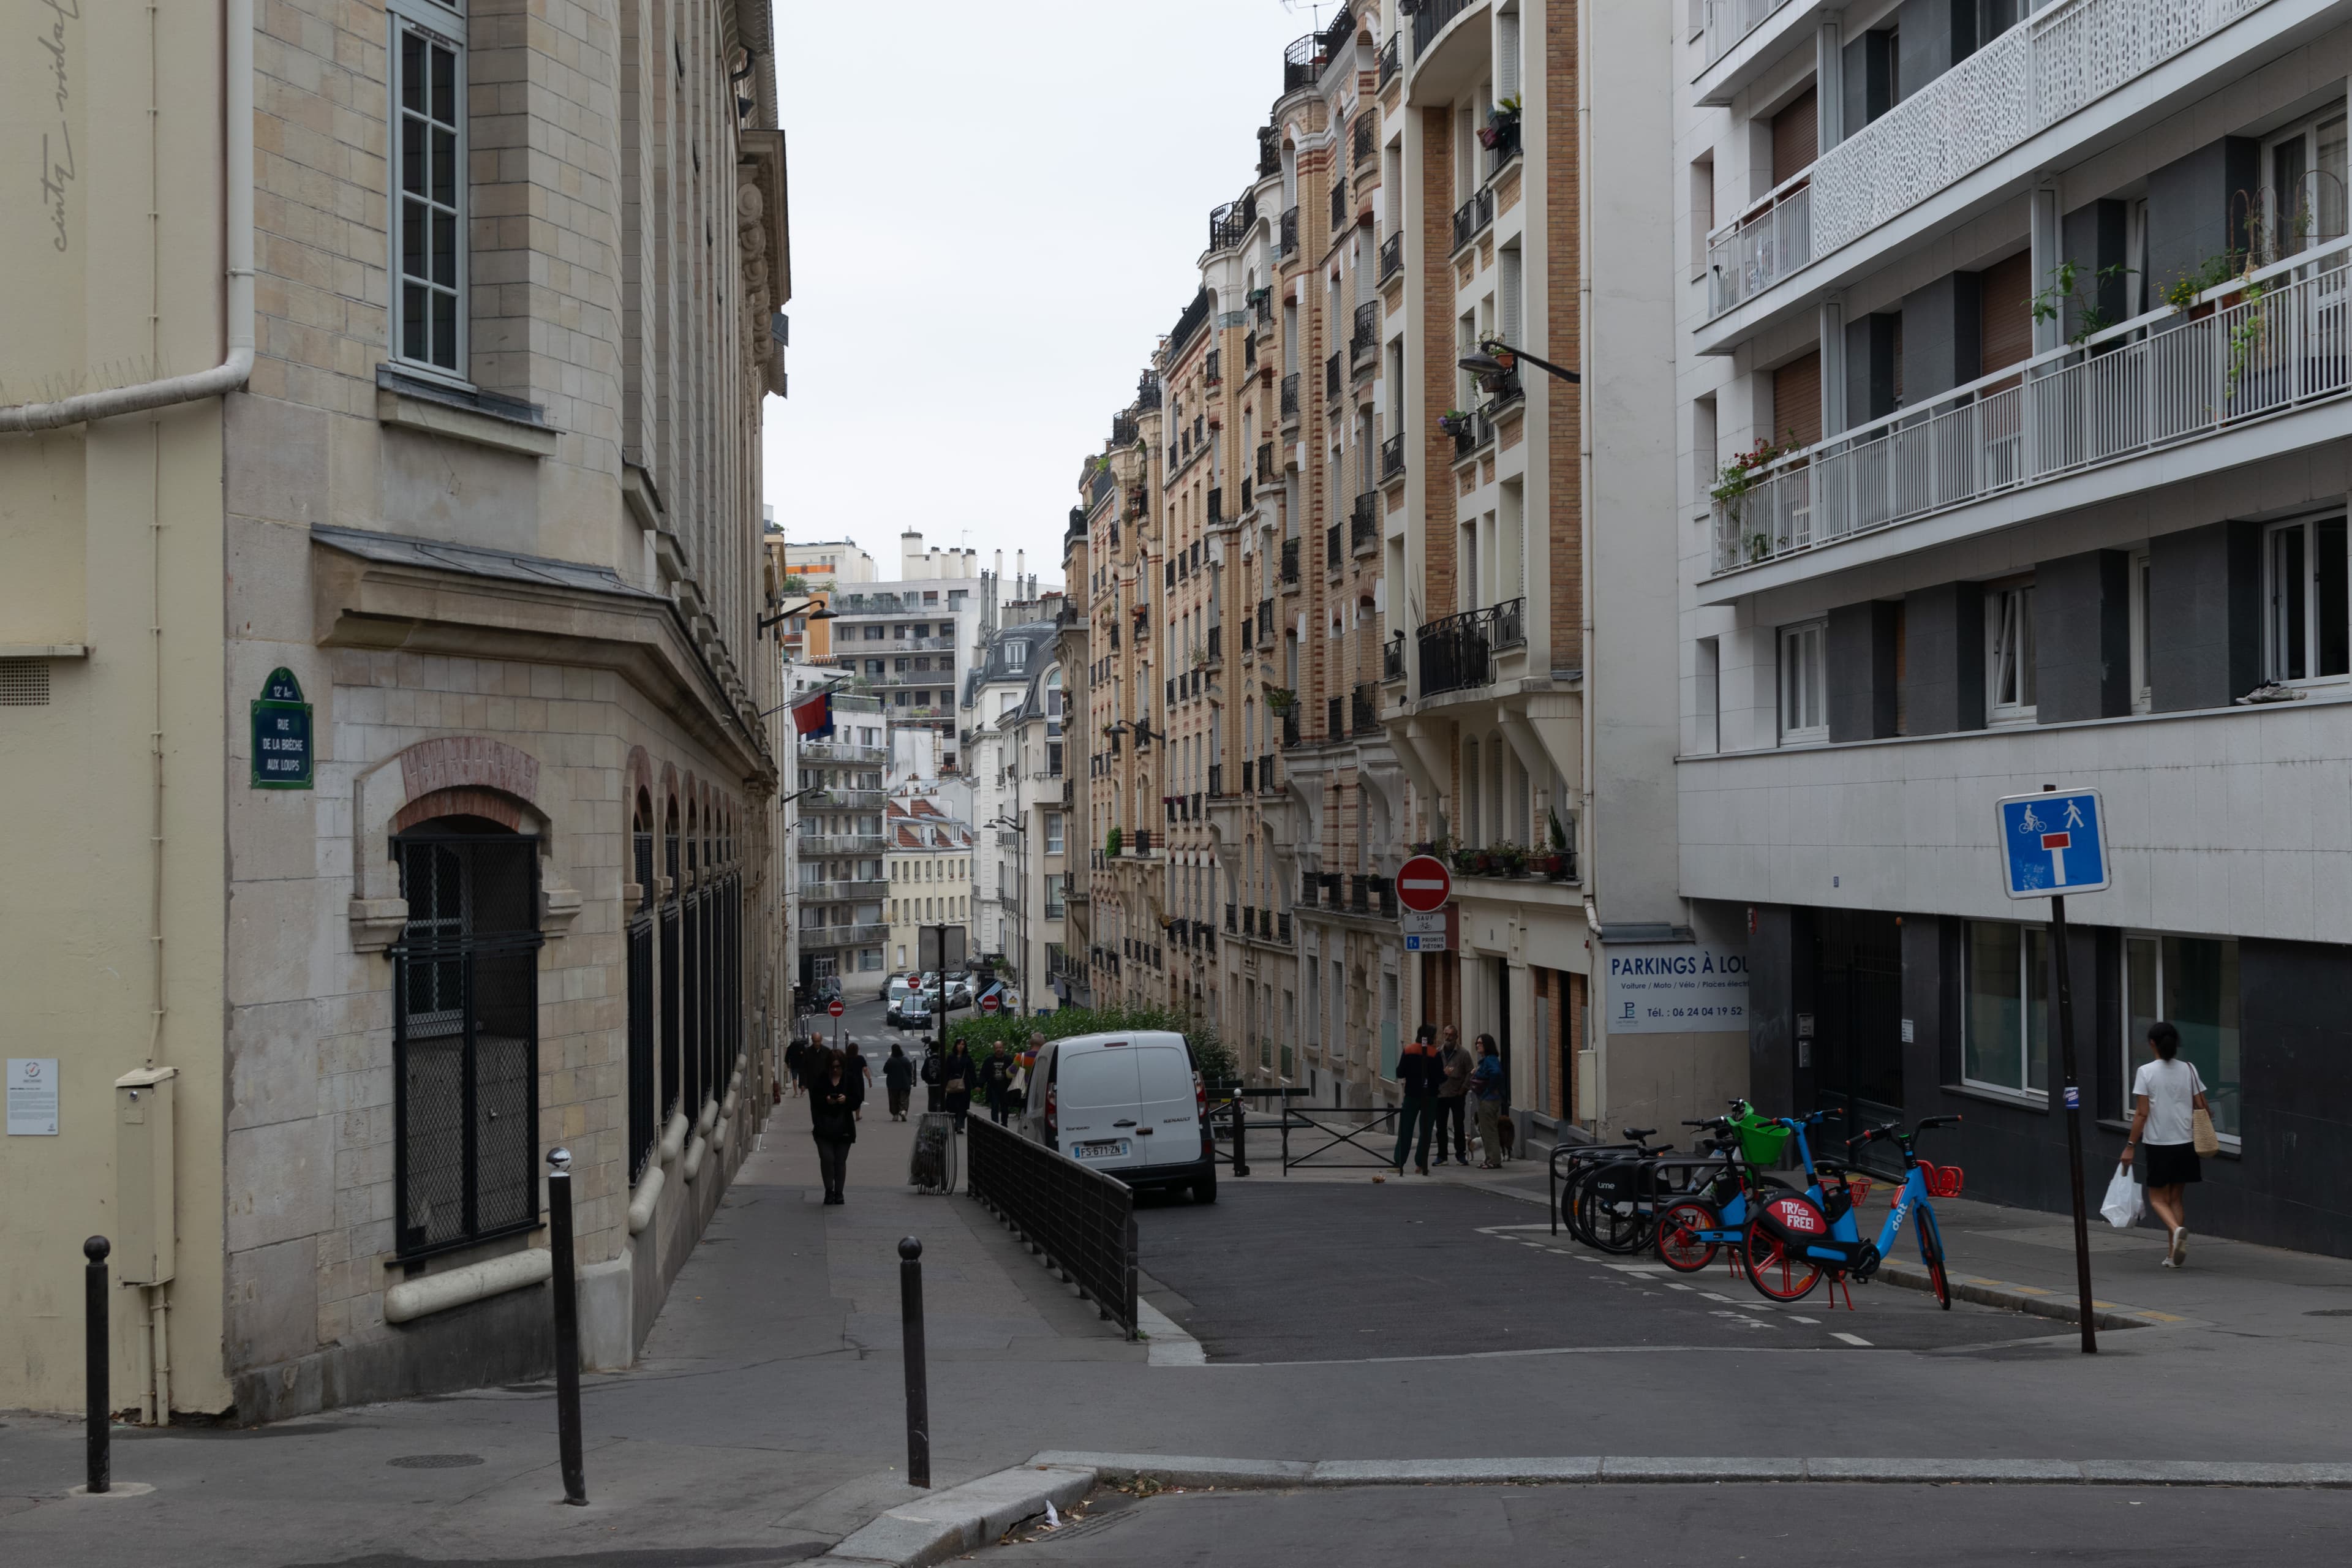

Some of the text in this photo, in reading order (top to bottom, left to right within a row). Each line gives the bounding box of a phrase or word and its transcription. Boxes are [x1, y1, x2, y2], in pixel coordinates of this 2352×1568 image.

[277, 718, 289, 730] RUE
[263, 737, 303, 752] DE LA BRÈCHE
[267, 758, 300, 771] AUX LOUPS
[1611, 956, 1696, 976] PARKINGS
[1702, 951, 1714, 974] À
[1648, 1008, 1664, 1017] Tél.
[1673, 1008, 1684, 1017] 06
[1687, 1008, 1699, 1017] 24
[1702, 1007, 1714, 1016] 04
[1717, 1007, 1728, 1016] 19
[1731, 1006, 1742, 1016] 52
[1080, 1145, 1121, 1157] FS-671-ZN
[1781, 1201, 1800, 1215] TRY
[1787, 1214, 1814, 1230] FREE!
[1891, 1203, 1909, 1231] dott
